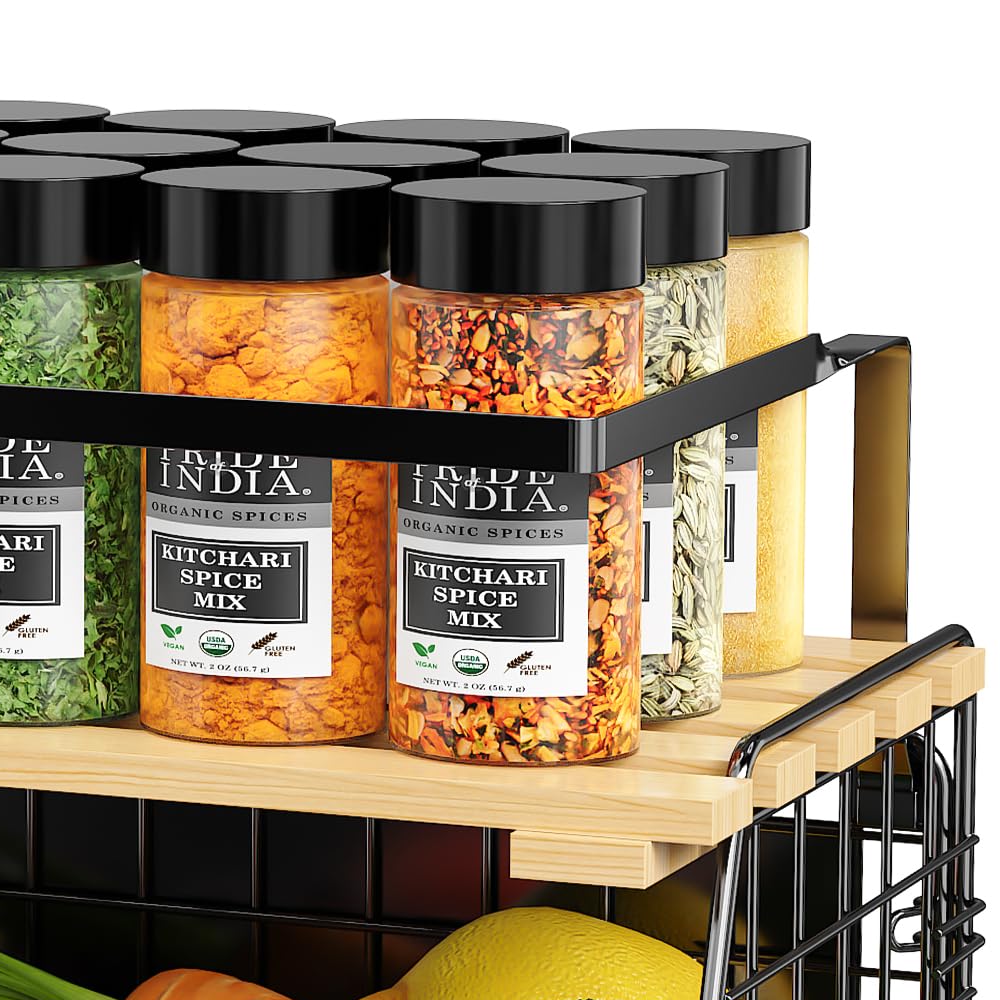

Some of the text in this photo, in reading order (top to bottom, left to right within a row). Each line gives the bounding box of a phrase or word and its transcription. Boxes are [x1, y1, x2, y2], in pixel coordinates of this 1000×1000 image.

[152, 501, 307, 521] ORGANIC SPICES
[403, 518, 564, 538] ORGANIC SPICES
[162, 544, 292, 567] KITCHARI
[180, 569, 262, 589] SPICE
[414, 561, 548, 586] KITCHARI
[194, 591, 246, 610] MIX
[433, 587, 518, 607] SPICE
[447, 610, 502, 629] MIX
[163, 642, 184, 650] VEGAN
[171, 658, 187, 666] NET
[189, 661, 206, 669] WT.
[415, 660, 437, 669] VEGAN
[423, 677, 440, 685] NET
[442, 680, 460, 688] WT.
